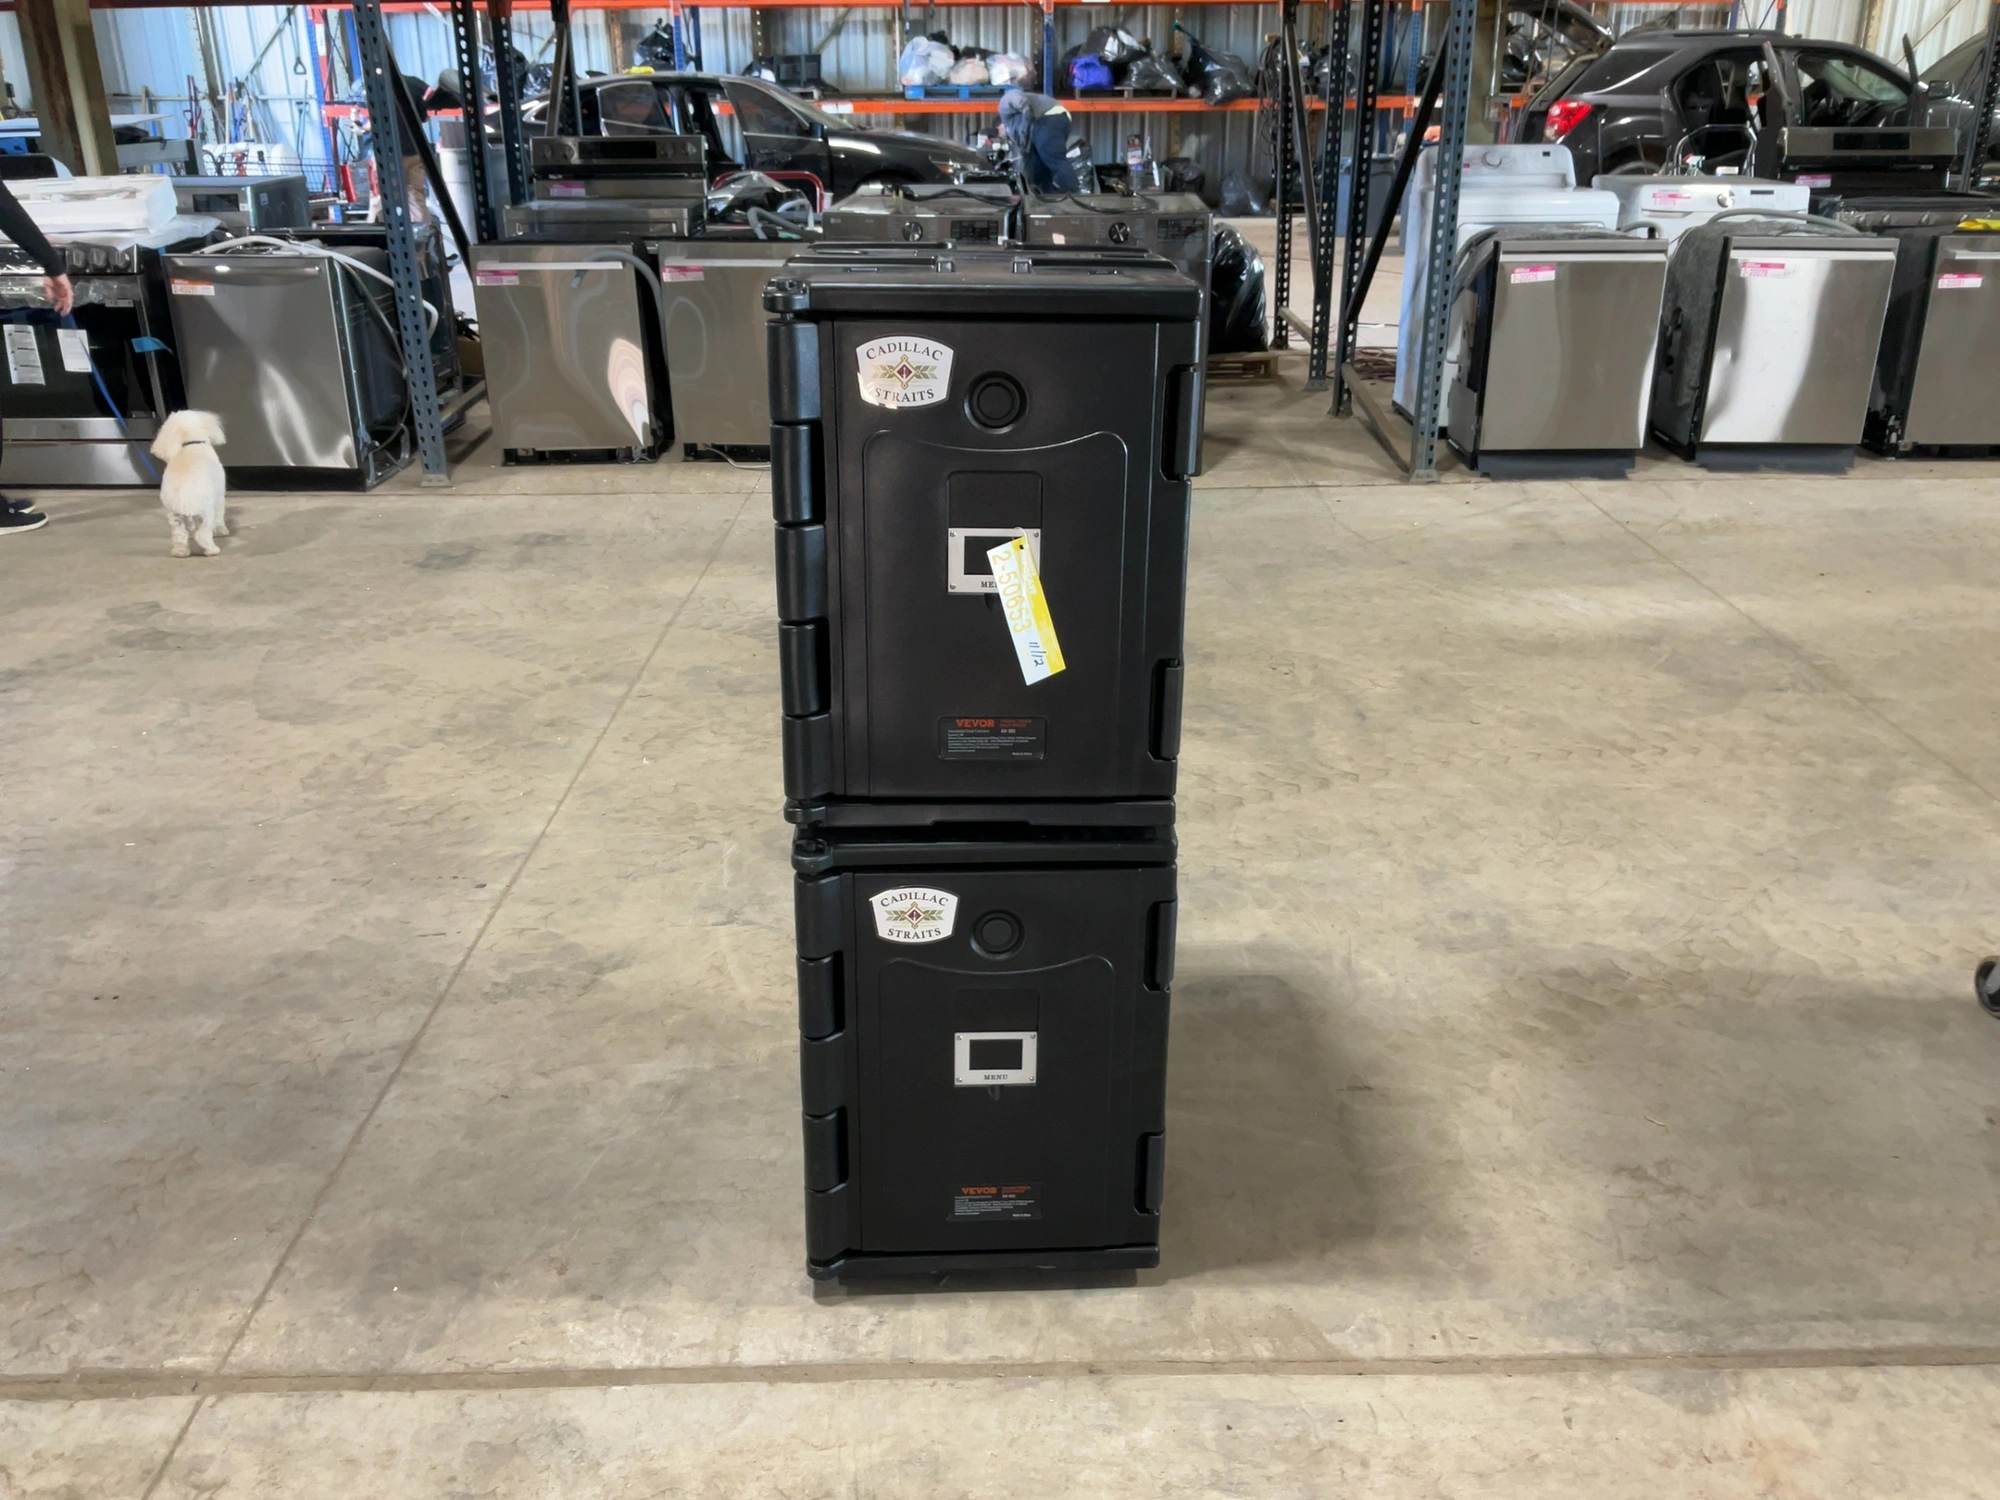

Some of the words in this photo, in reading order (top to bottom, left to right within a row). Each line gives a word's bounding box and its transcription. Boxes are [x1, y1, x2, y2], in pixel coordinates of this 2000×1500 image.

[866, 342, 943, 361] CADILLAC
[875, 388, 934, 402] STRAITS
[992, 550, 1033, 634] 2-50653
[1029, 641, 1047, 667] 11/12
[955, 718, 995, 728] VEVOR
[880, 892, 949, 907] CADILLAC
[887, 927, 941, 939] STRAITS
